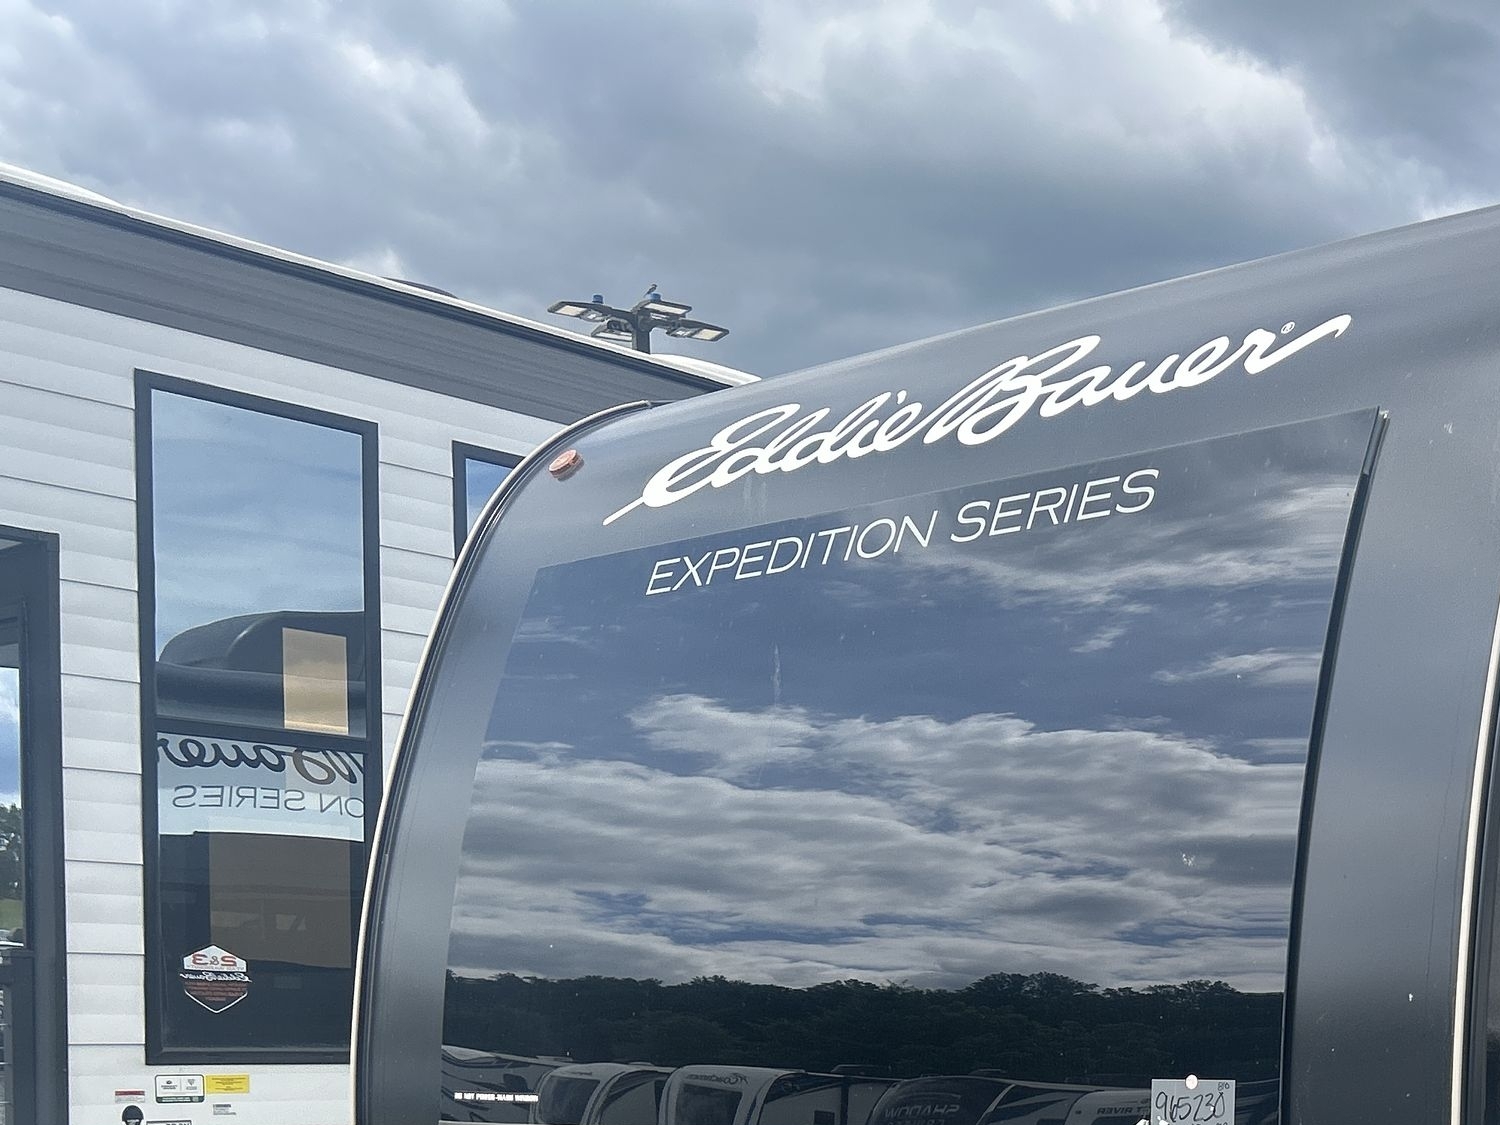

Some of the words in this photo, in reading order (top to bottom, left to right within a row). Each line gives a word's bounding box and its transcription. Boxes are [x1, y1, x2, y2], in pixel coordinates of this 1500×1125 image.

[603, 388, 927, 526] Eddie
[645, 508, 939, 597] EXPEDITION
[950, 468, 1160, 544] SERIES
